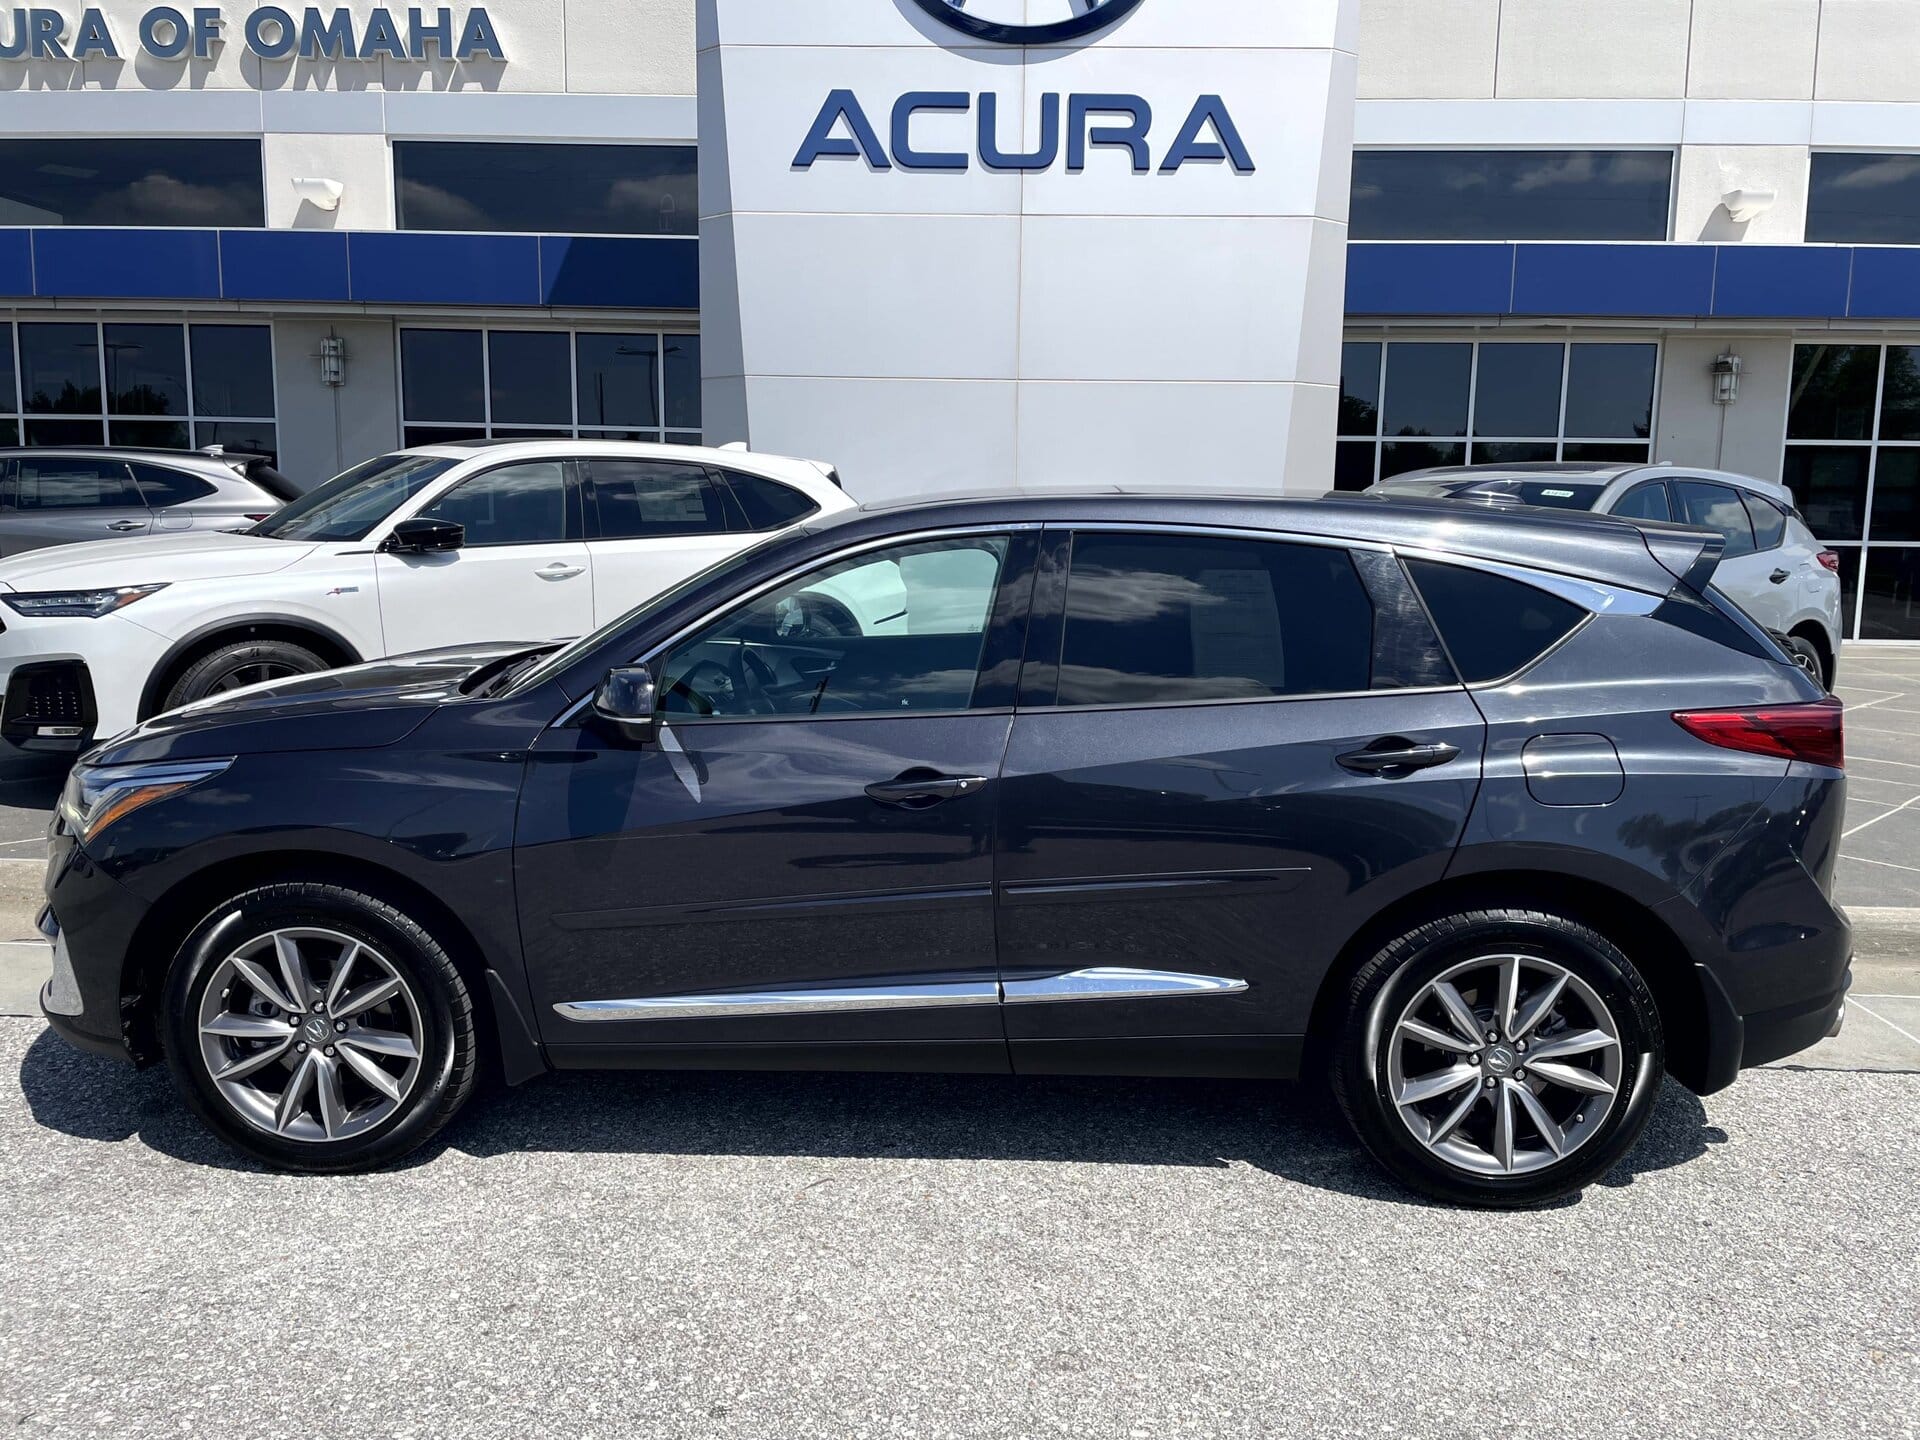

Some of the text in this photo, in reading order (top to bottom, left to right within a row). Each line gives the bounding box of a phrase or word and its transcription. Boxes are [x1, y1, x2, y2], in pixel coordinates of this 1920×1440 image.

[138, 6, 222, 59] OF
[244, 6, 506, 60] OMAHA
[791, 88, 1256, 173] ACURA
